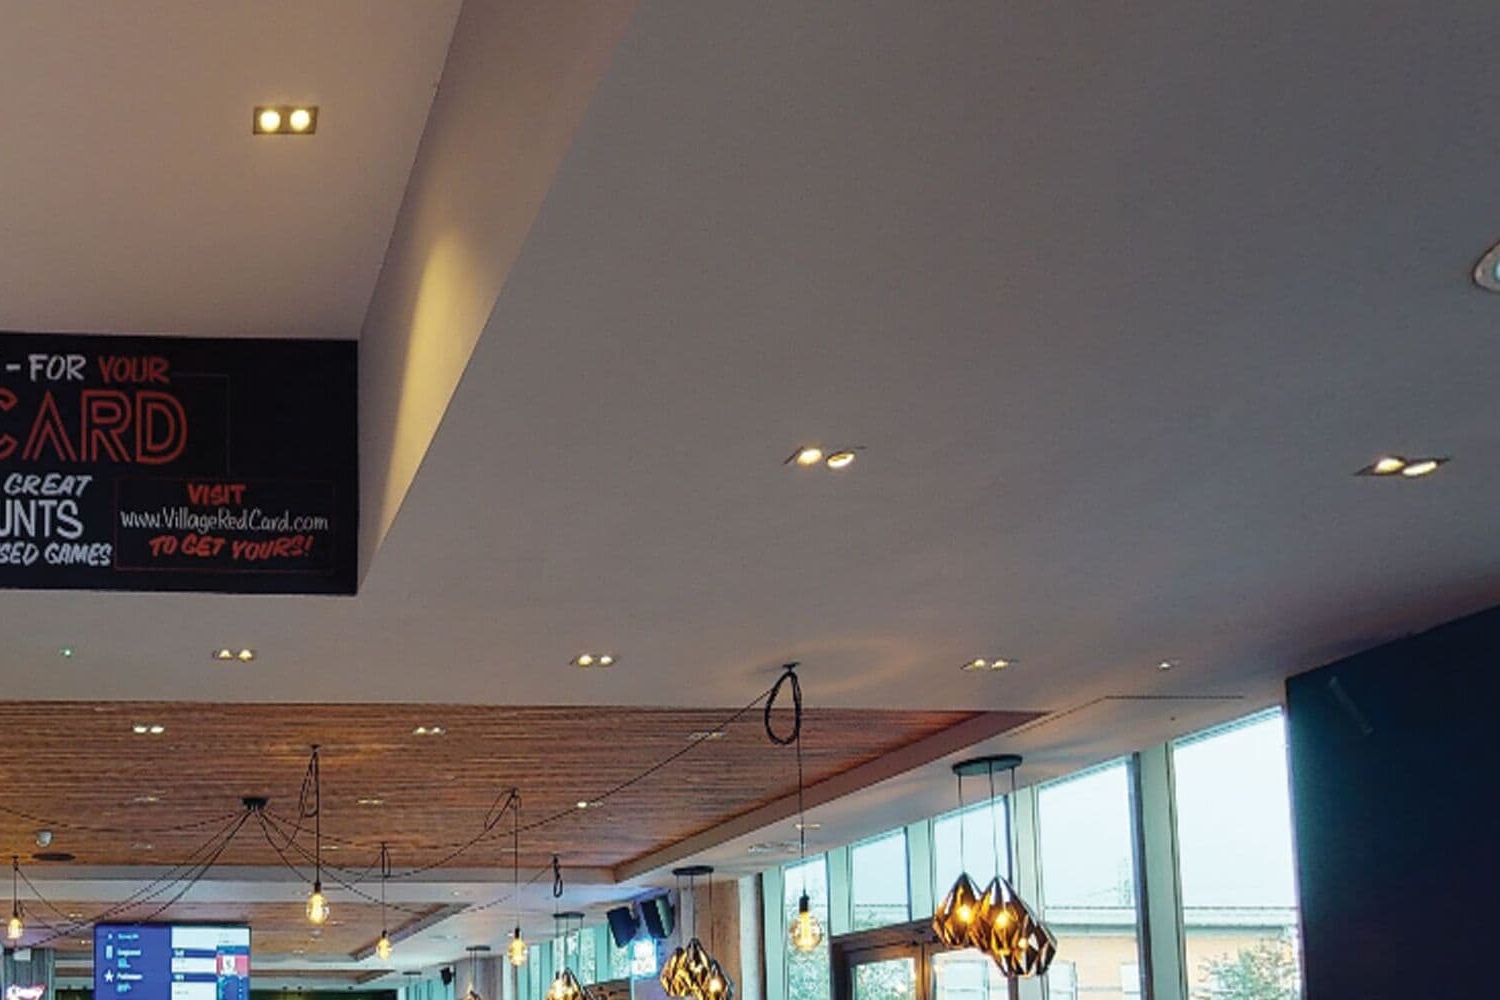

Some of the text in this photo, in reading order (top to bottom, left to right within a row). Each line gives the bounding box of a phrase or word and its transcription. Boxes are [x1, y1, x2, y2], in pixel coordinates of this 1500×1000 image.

[28, 353, 87, 381] FOR
[99, 355, 170, 384] YOUR
[3, 473, 92, 497] GREAT
[186, 483, 246, 505] VISIT
[119, 506, 328, 534] www.VillageRedCard.com
[44, 542, 113, 566] GAMES
[149, 533, 314, 561] TO GET YOURS!
